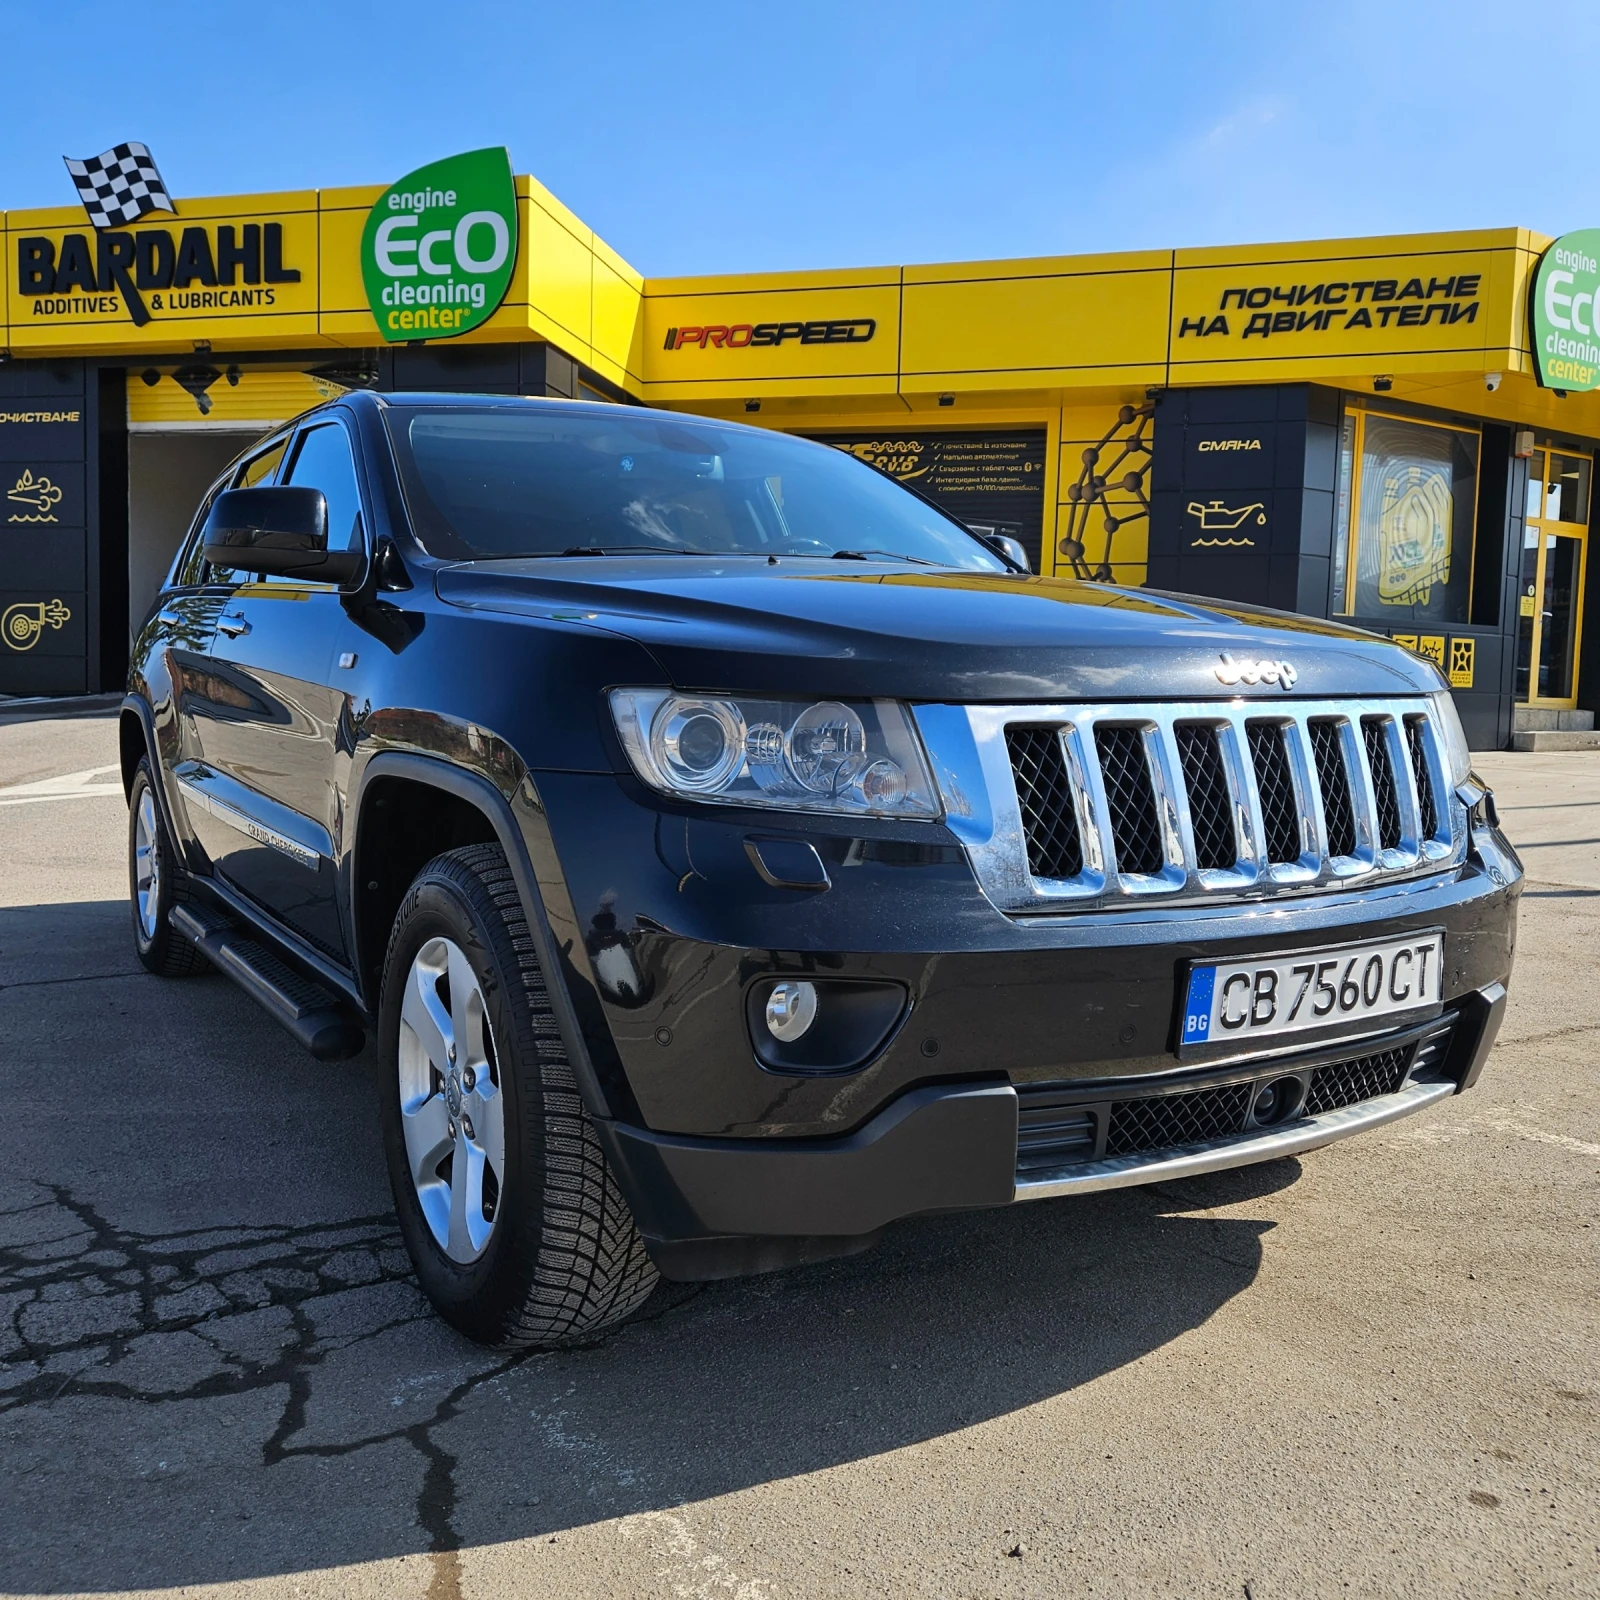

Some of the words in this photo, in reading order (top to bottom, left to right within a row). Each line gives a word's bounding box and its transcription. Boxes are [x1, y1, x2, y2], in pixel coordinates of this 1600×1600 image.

[388, 187, 457, 213] engine
[374, 210, 510, 277] EcO
[18, 222, 301, 327] BARDAHL
[1555, 248, 1598, 275] engine
[33, 296, 119, 316] ADDITIVES
[151, 293, 165, 311] &
[169, 288, 276, 310] LUBRICANTS
[381, 278, 486, 309] cleaning
[1219, 274, 1482, 310] ПОЧИСТВАНЕ
[1544, 269, 1600, 340] Ec
[674, 318, 877, 350] PROSPEED
[1178, 315, 1230, 338] НА
[1241, 301, 1481, 339] ДВИГАТЕЛИ
[1545, 331, 1600, 371] cleanin
[1198, 439, 1262, 451] СМЯНА
[939, 465, 976, 473] Свързване
[1213, 652, 1298, 691] Jeep
[1220, 968, 1279, 1030] CB
[1286, 954, 1383, 1022] 7560
[1389, 943, 1436, 1002] CT
[1187, 1014, 1208, 1033] BG
